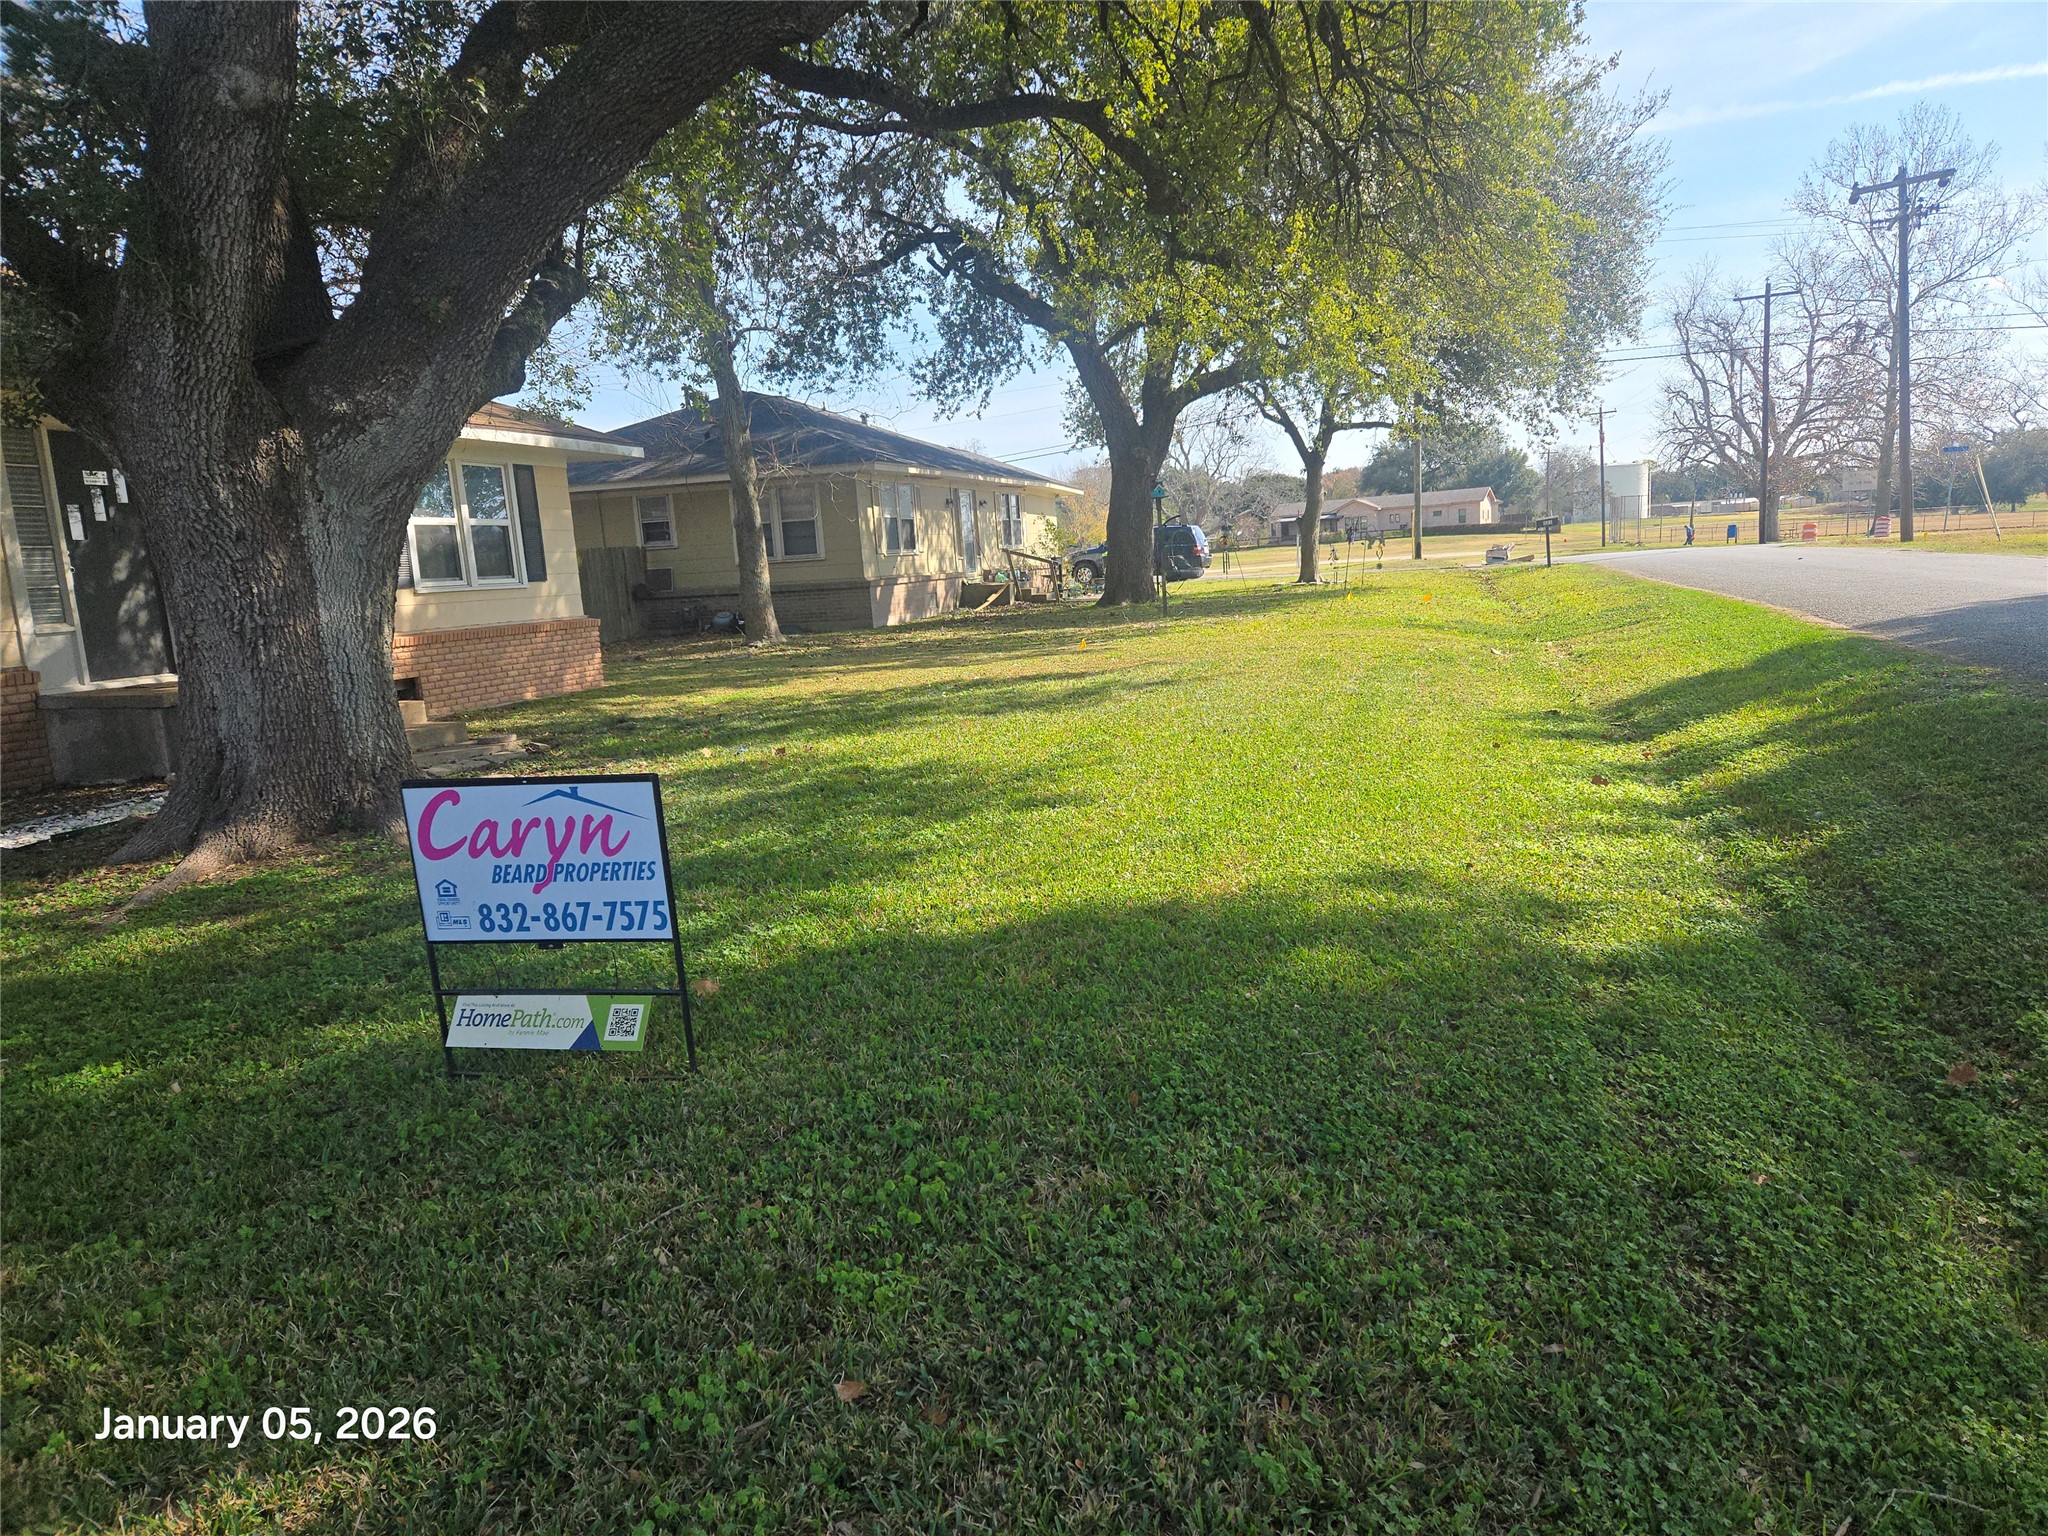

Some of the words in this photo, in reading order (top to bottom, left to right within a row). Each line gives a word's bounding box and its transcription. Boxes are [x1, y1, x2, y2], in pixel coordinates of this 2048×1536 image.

[417, 789, 630, 895] Caryn
[491, 863, 547, 884] BEARD
[553, 861, 656, 883] PROPERTIES
[477, 900, 668, 933] 832-867-7575
